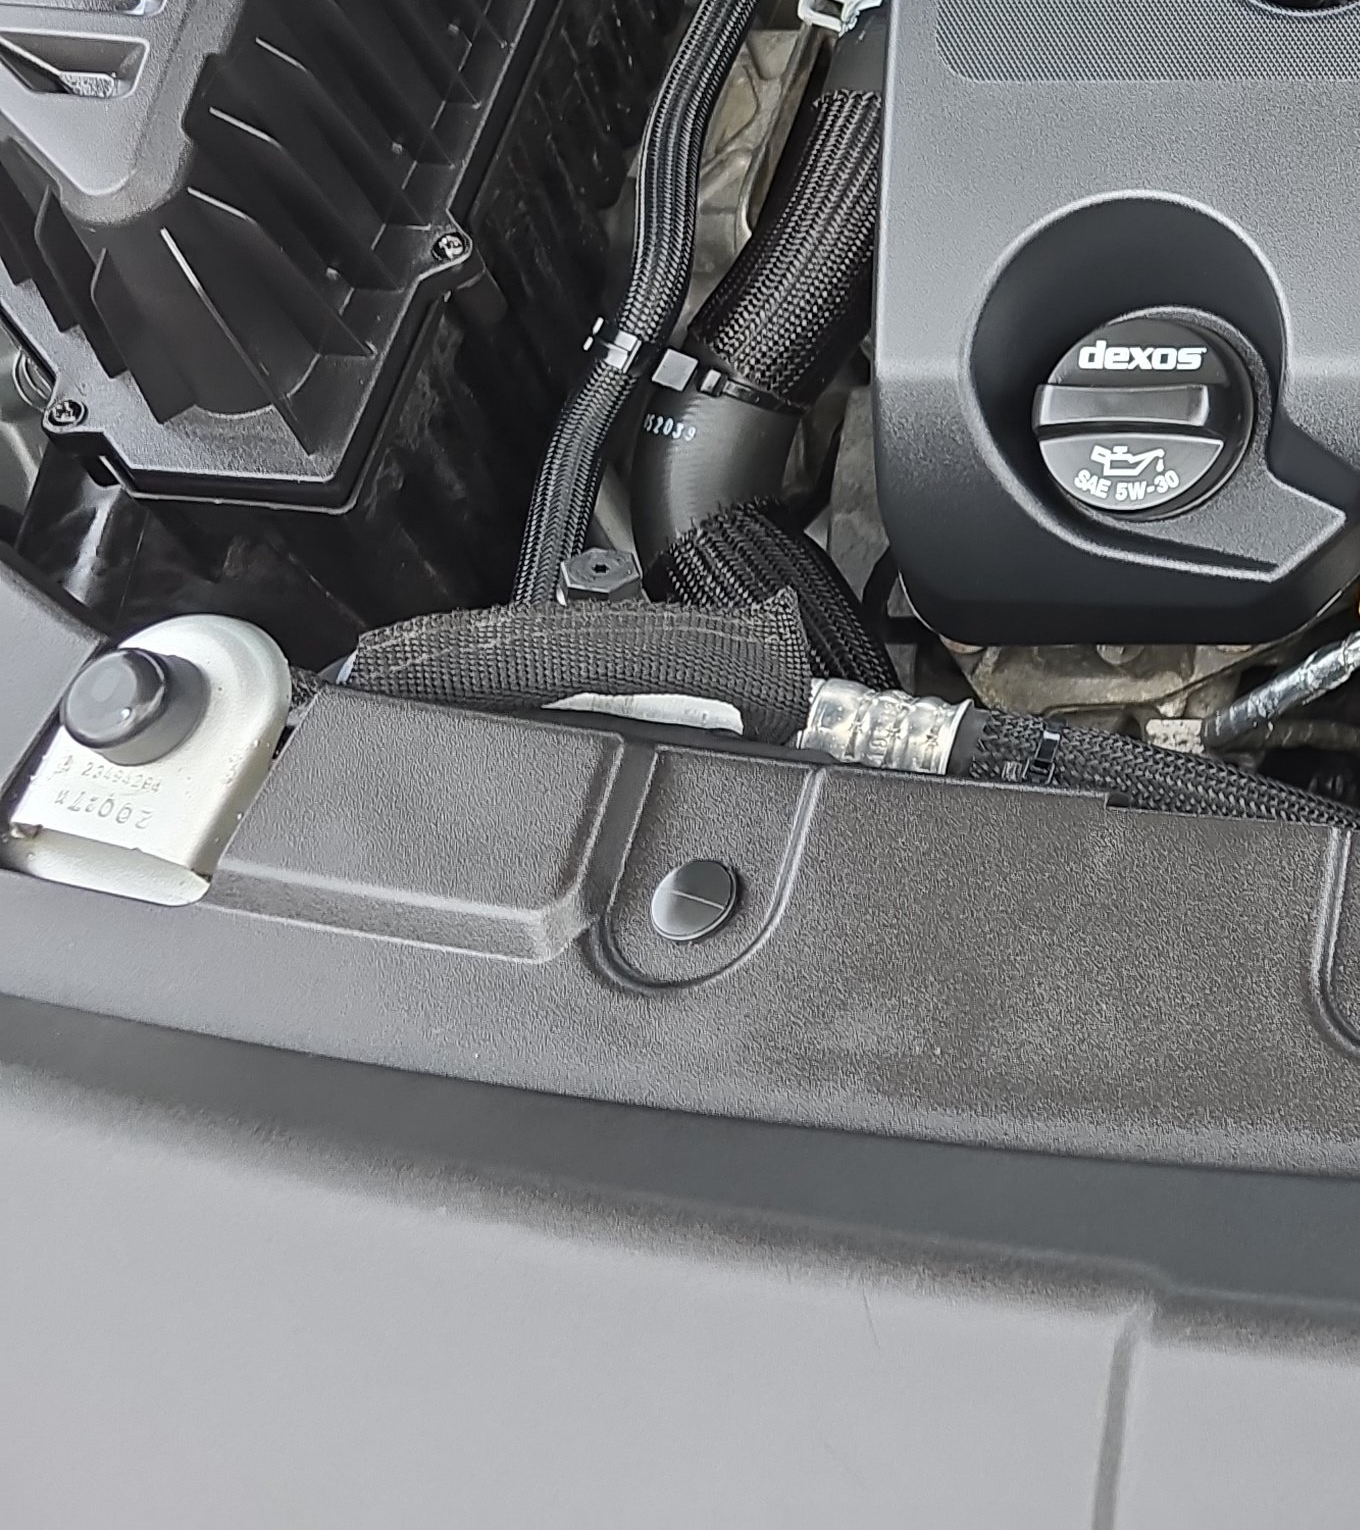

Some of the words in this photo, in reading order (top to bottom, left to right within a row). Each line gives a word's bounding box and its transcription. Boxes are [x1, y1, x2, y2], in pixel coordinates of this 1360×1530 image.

[1078, 340, 1204, 370] dexos
[1074, 469, 1111, 499] SAE
[1115, 470, 1180, 501] 5W-30
